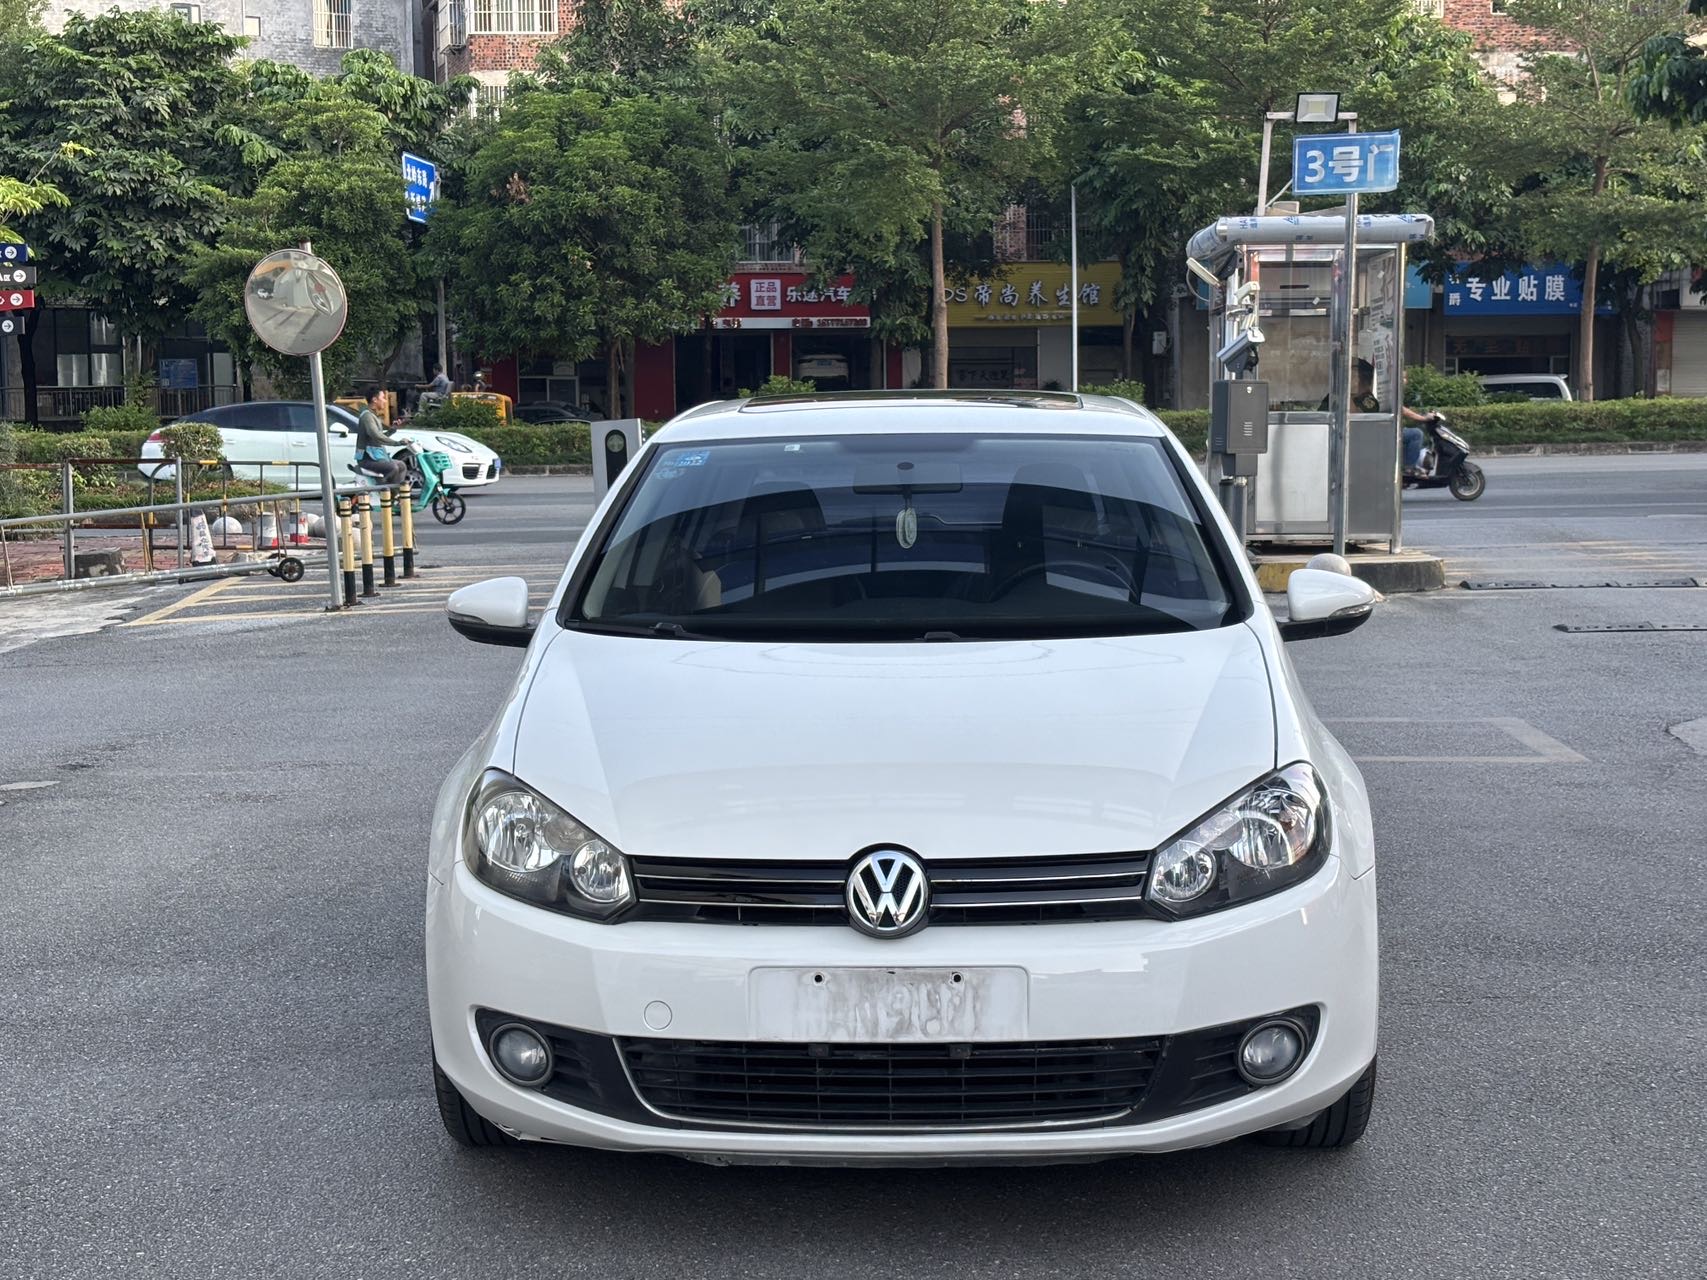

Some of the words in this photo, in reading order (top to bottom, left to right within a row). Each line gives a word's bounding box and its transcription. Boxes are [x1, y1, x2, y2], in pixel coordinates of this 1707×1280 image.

[1304, 144, 1394, 183] 3号门
[754, 281, 777, 293] 正品
[974, 280, 1102, 307] 帝尚养生馆
[1466, 274, 1566, 302] 专业贴膜
